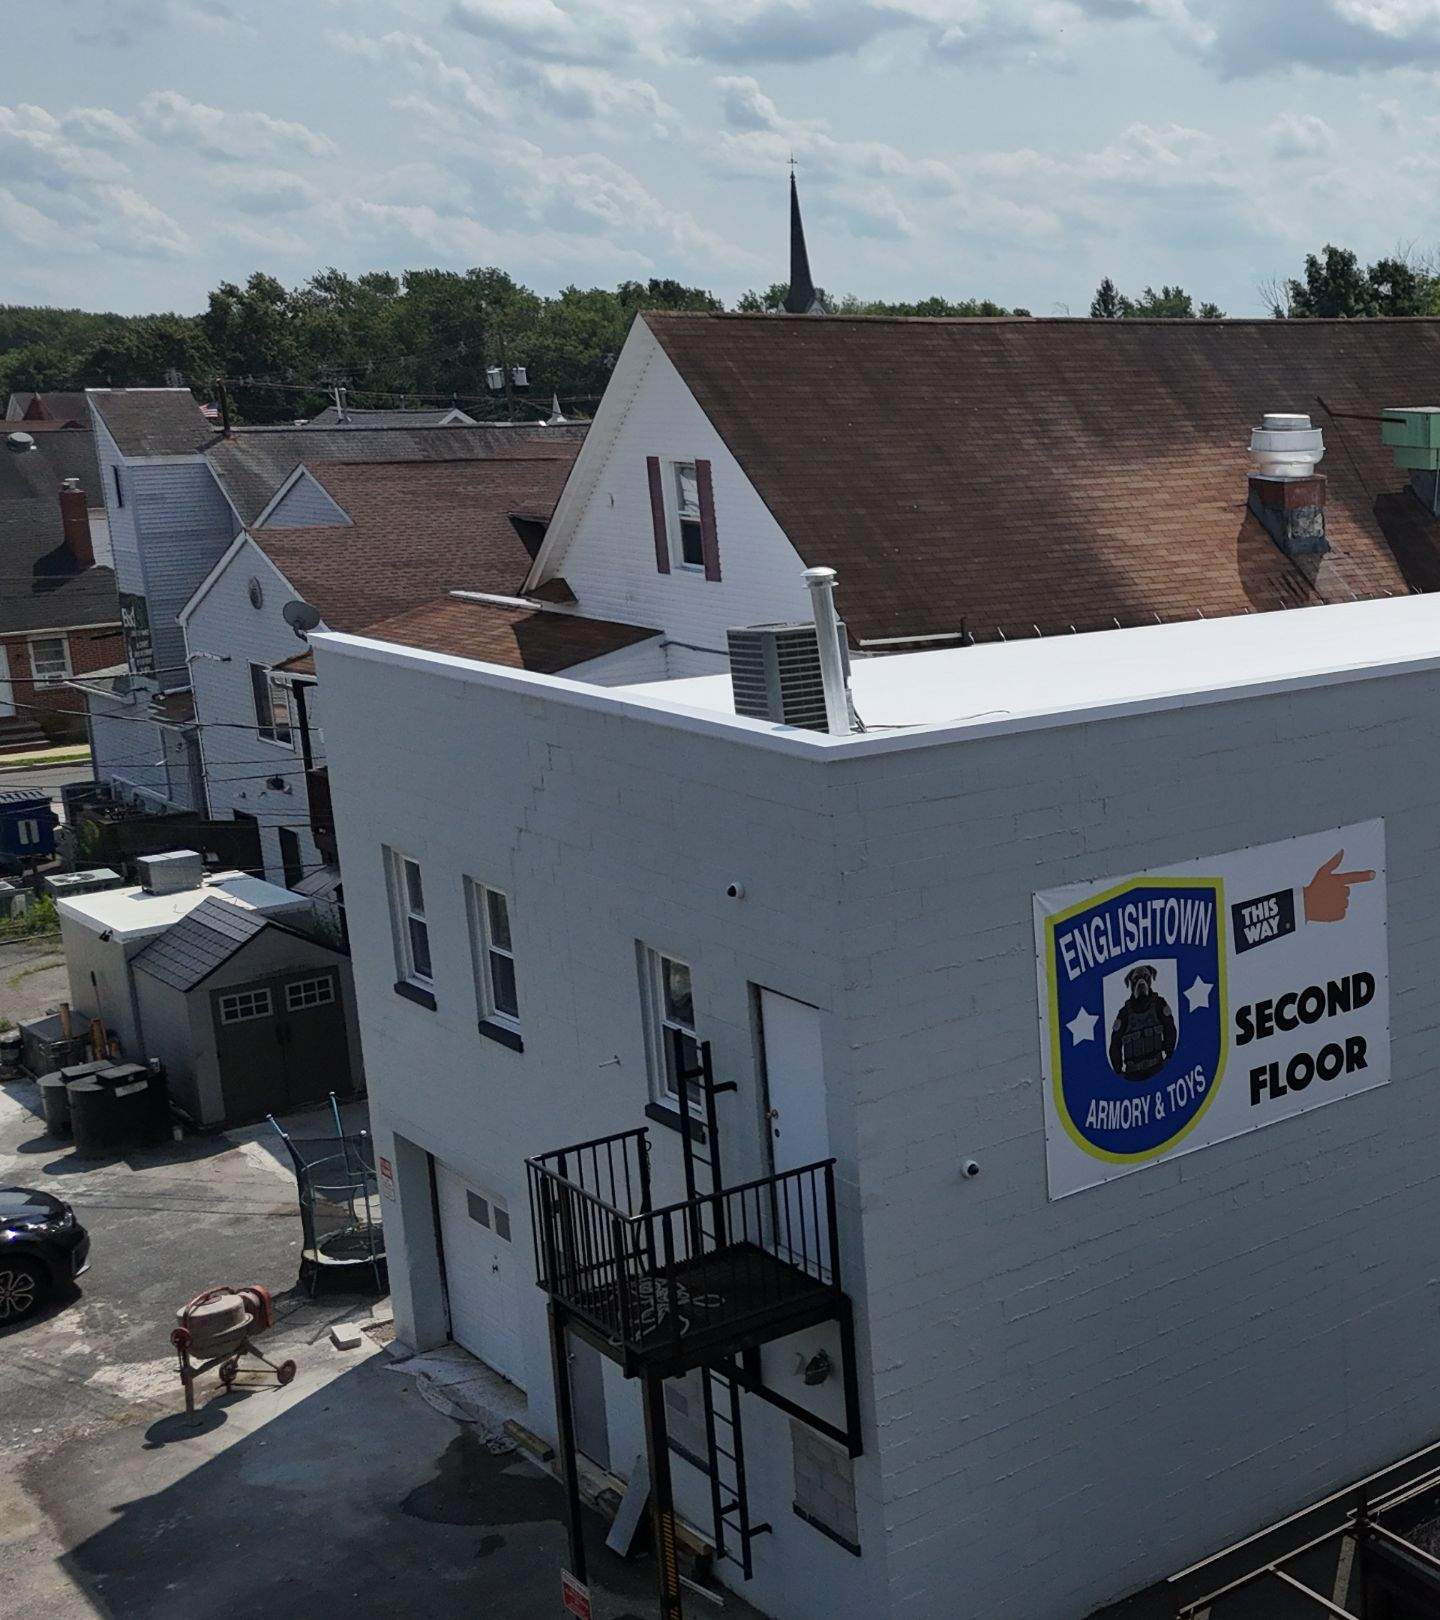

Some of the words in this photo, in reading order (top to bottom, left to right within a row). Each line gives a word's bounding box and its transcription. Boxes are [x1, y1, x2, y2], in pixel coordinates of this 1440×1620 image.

[1059, 897, 1213, 981] ENGLISHTOWN
[1241, 897, 1280, 926] THIS
[1243, 912, 1281, 945] WAY
[1235, 971, 1376, 1046] SECOND
[1085, 1092, 1150, 1130] ARMORY
[1154, 1096, 1166, 1120] &
[1166, 1065, 1207, 1113] TOYS
[1249, 1035, 1368, 1106] FLOOR
